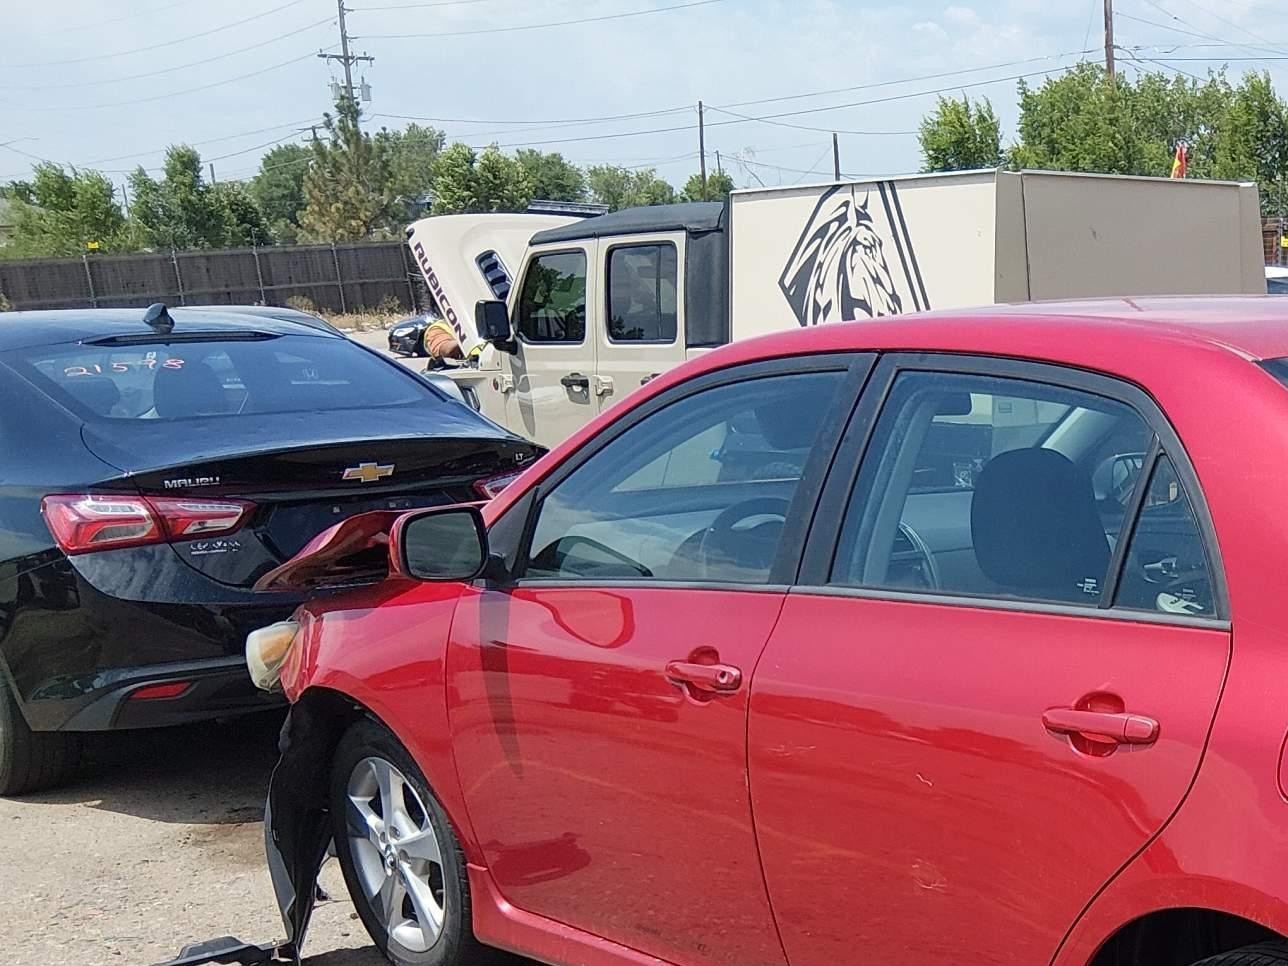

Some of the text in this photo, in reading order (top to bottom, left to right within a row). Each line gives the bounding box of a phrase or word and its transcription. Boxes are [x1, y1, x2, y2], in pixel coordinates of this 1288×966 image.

[413, 241, 467, 343] RUBICON
[515, 453, 524, 461] LT
[163, 476, 221, 489] MALIBU
